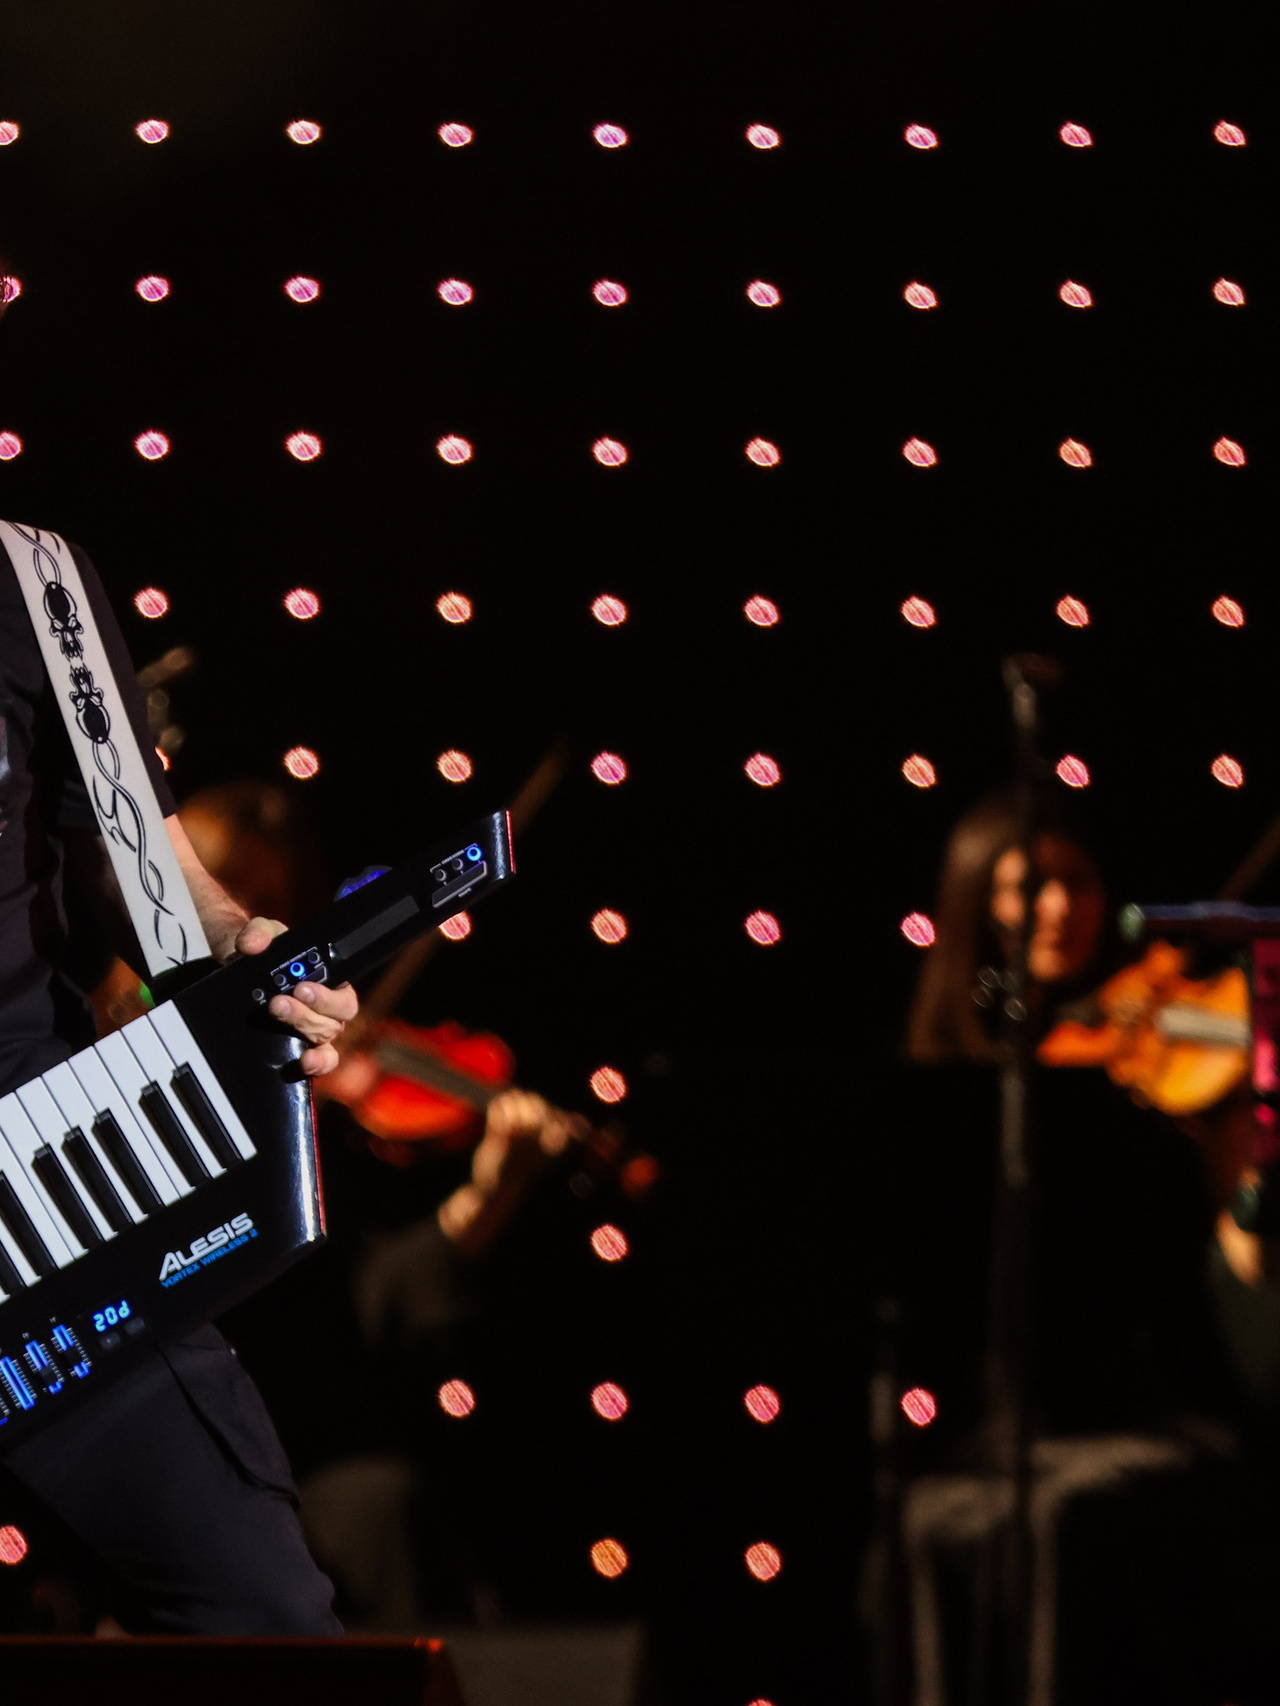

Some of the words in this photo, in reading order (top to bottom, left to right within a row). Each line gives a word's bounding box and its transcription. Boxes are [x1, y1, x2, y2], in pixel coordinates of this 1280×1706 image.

[158, 1212, 254, 1282] ALESIS
[160, 1263, 201, 1288] VORTEX
[200, 1234, 250, 1265] WIRELESS
